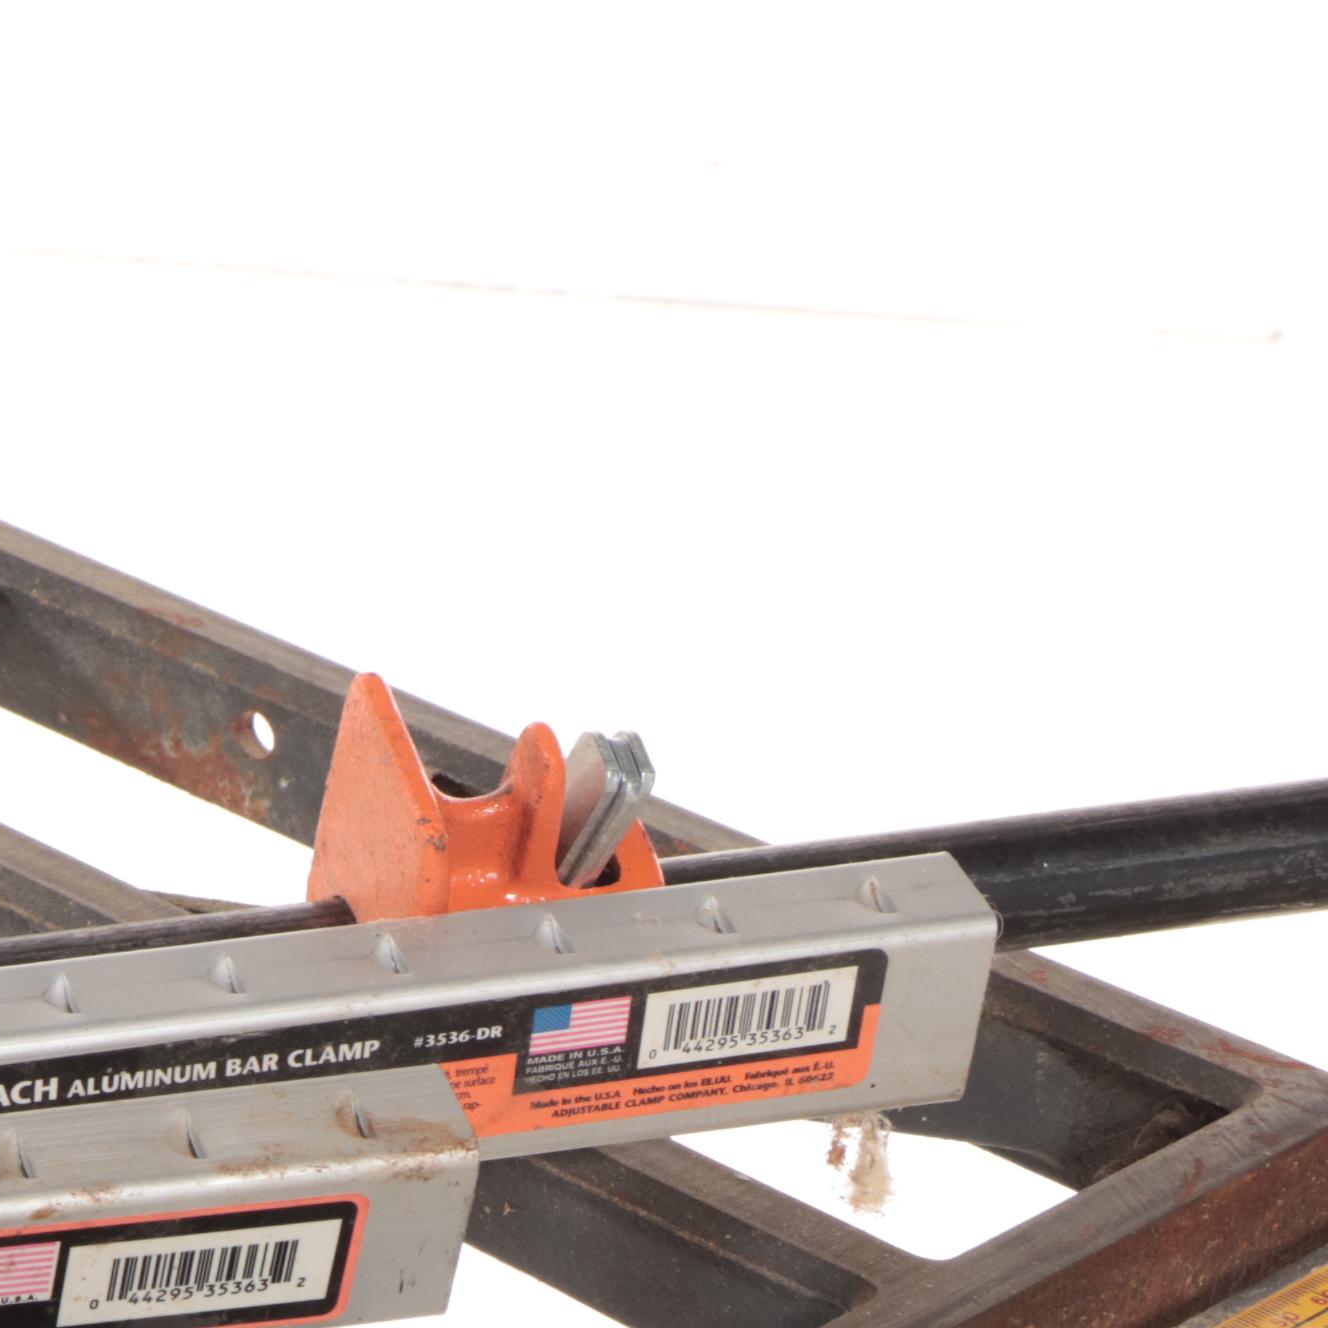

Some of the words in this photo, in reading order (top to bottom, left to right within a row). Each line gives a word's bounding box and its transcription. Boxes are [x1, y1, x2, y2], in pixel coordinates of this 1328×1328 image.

[648, 1048, 658, 1060] 0
[682, 1034, 739, 1054] 44295
[746, 1025, 805, 1047] 35363
[828, 1024, 837, 1035] 2
[66, 1059, 217, 1099] ALUMINUM
[225, 1052, 279, 1077] BAR
[287, 1038, 381, 1067] CLAMP
[412, 1024, 504, 1049] #3536-DR
[526, 1052, 566, 1066] MADE
[569, 1050, 584, 1060] IN
[586, 1045, 626, 1058] U.S.A.
[577, 1058, 598, 1068] AUX
[557, 1070, 570, 1081] EN
[571, 1068, 590, 1078] LOS
[551, 1101, 621, 1119] ADJUSTABLE
[624, 1094, 665, 1108] CLAMP
[88, 1298, 100, 1310] 0
[127, 1286, 194, 1306] 44295
[203, 1277, 270, 1298] 35363
[295, 1276, 307, 1288] 2
